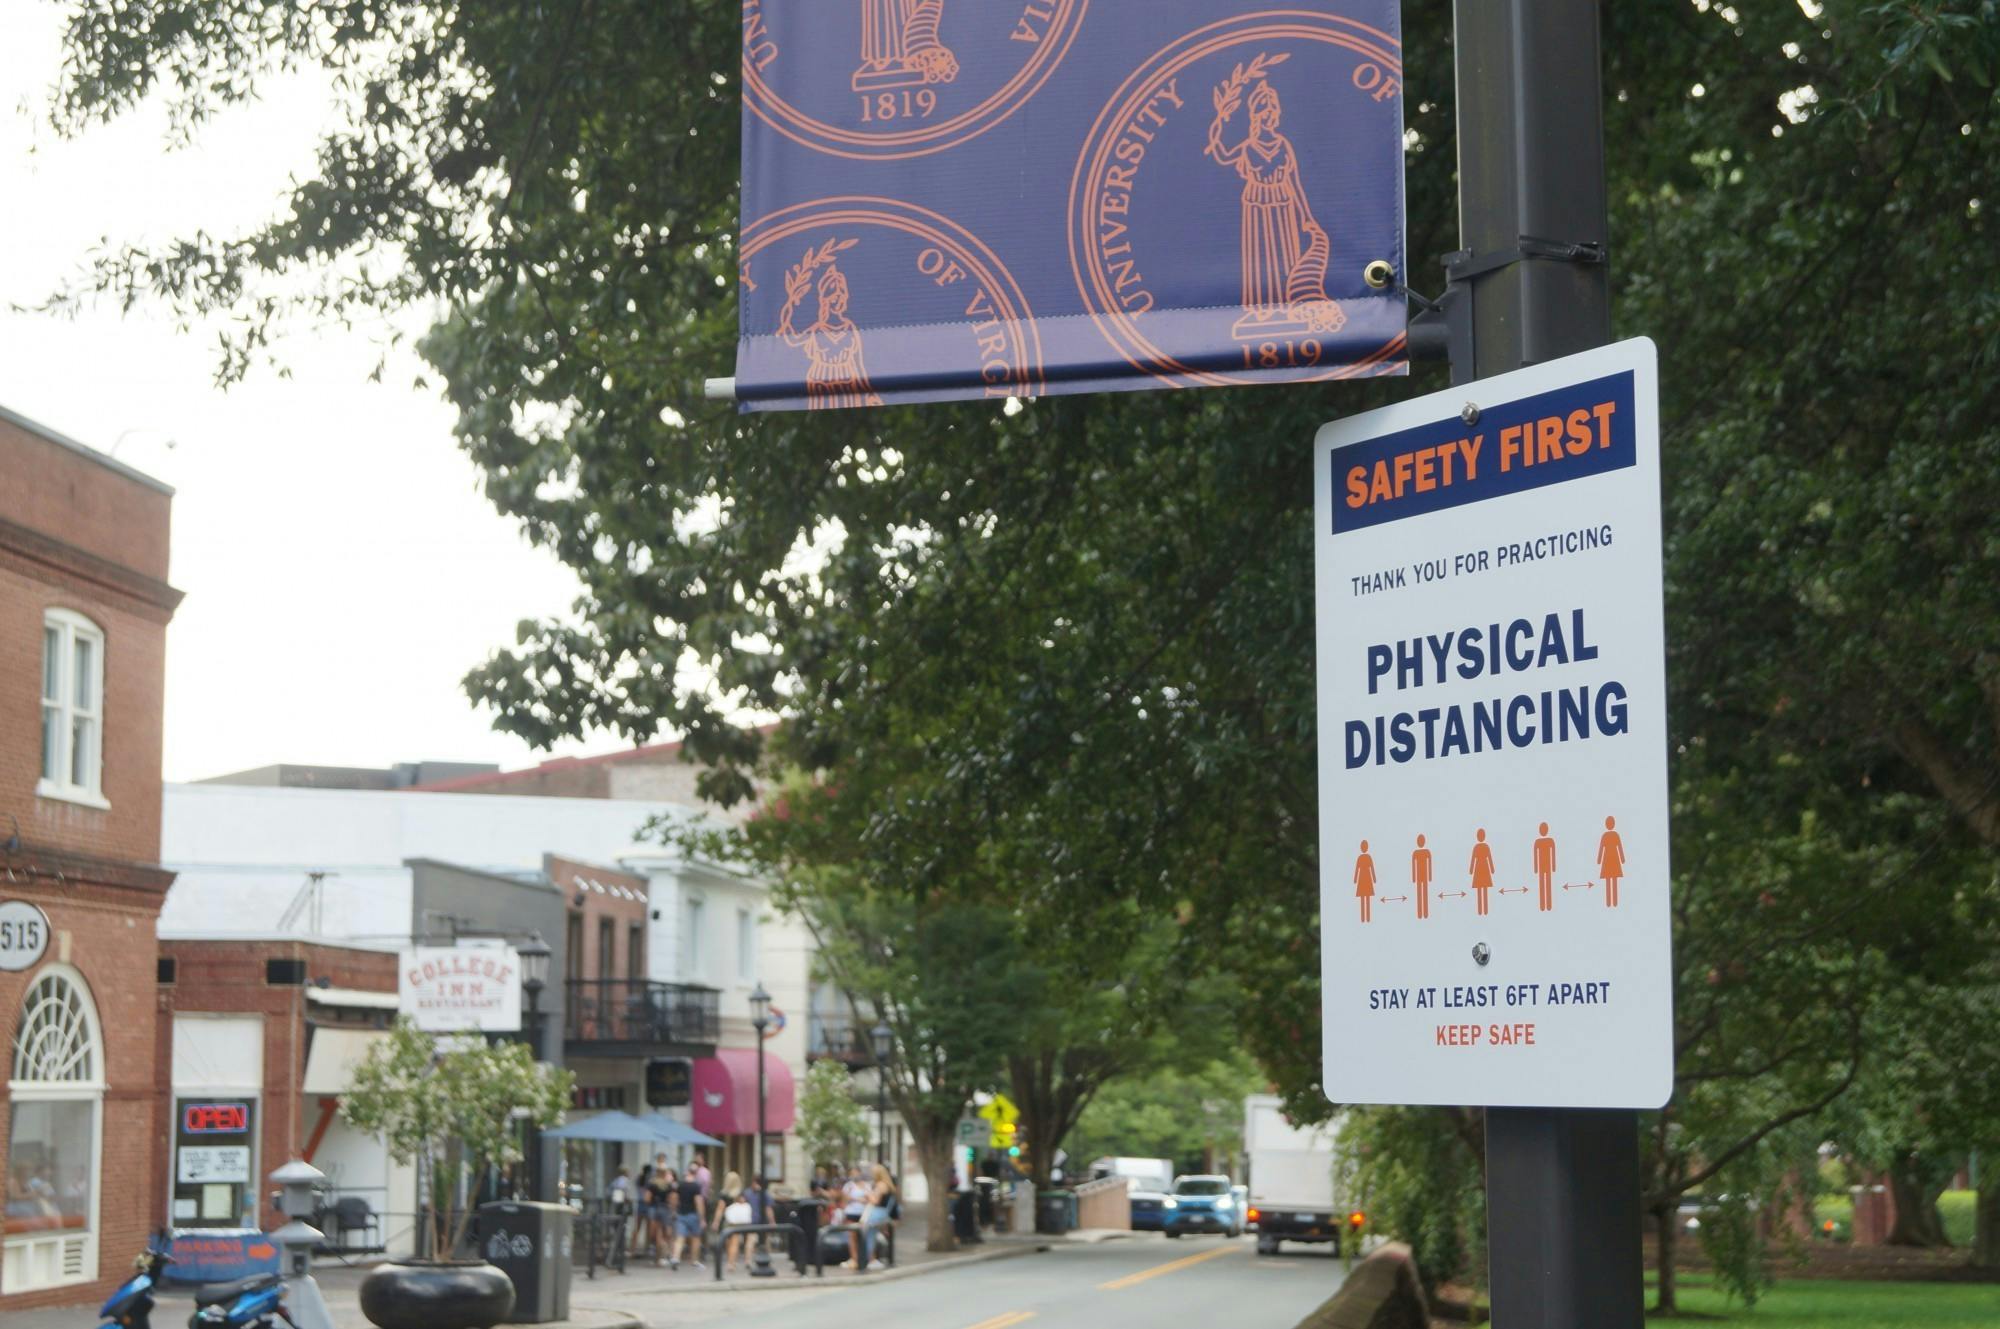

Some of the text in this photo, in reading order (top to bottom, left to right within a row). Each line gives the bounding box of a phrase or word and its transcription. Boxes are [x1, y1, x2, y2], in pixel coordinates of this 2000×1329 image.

[1010, 0, 1056, 42] IA
[861, 89, 937, 122] 1819
[1100, 62, 1402, 320] UNIVERSITY OF
[917, 248, 967, 287] OF
[1241, 339, 1323, 369] 1819
[1345, 401, 1616, 509] SAFETY FIRST
[1351, 524, 1613, 597] THANK YOU FOR PRACTICING
[1367, 608, 1599, 695] PHYSICAL
[1344, 681, 1629, 770] DISTANCING
[0, 921, 39, 951] 515
[408, 957, 513, 987] COLLEGE
[437, 982, 485, 997] INN
[1369, 982, 1611, 1010] STAY AT LEAST 6FT APART
[1436, 1024, 1536, 1046] KEEP SAFE
[187, 1105, 247, 1131] OPEN
